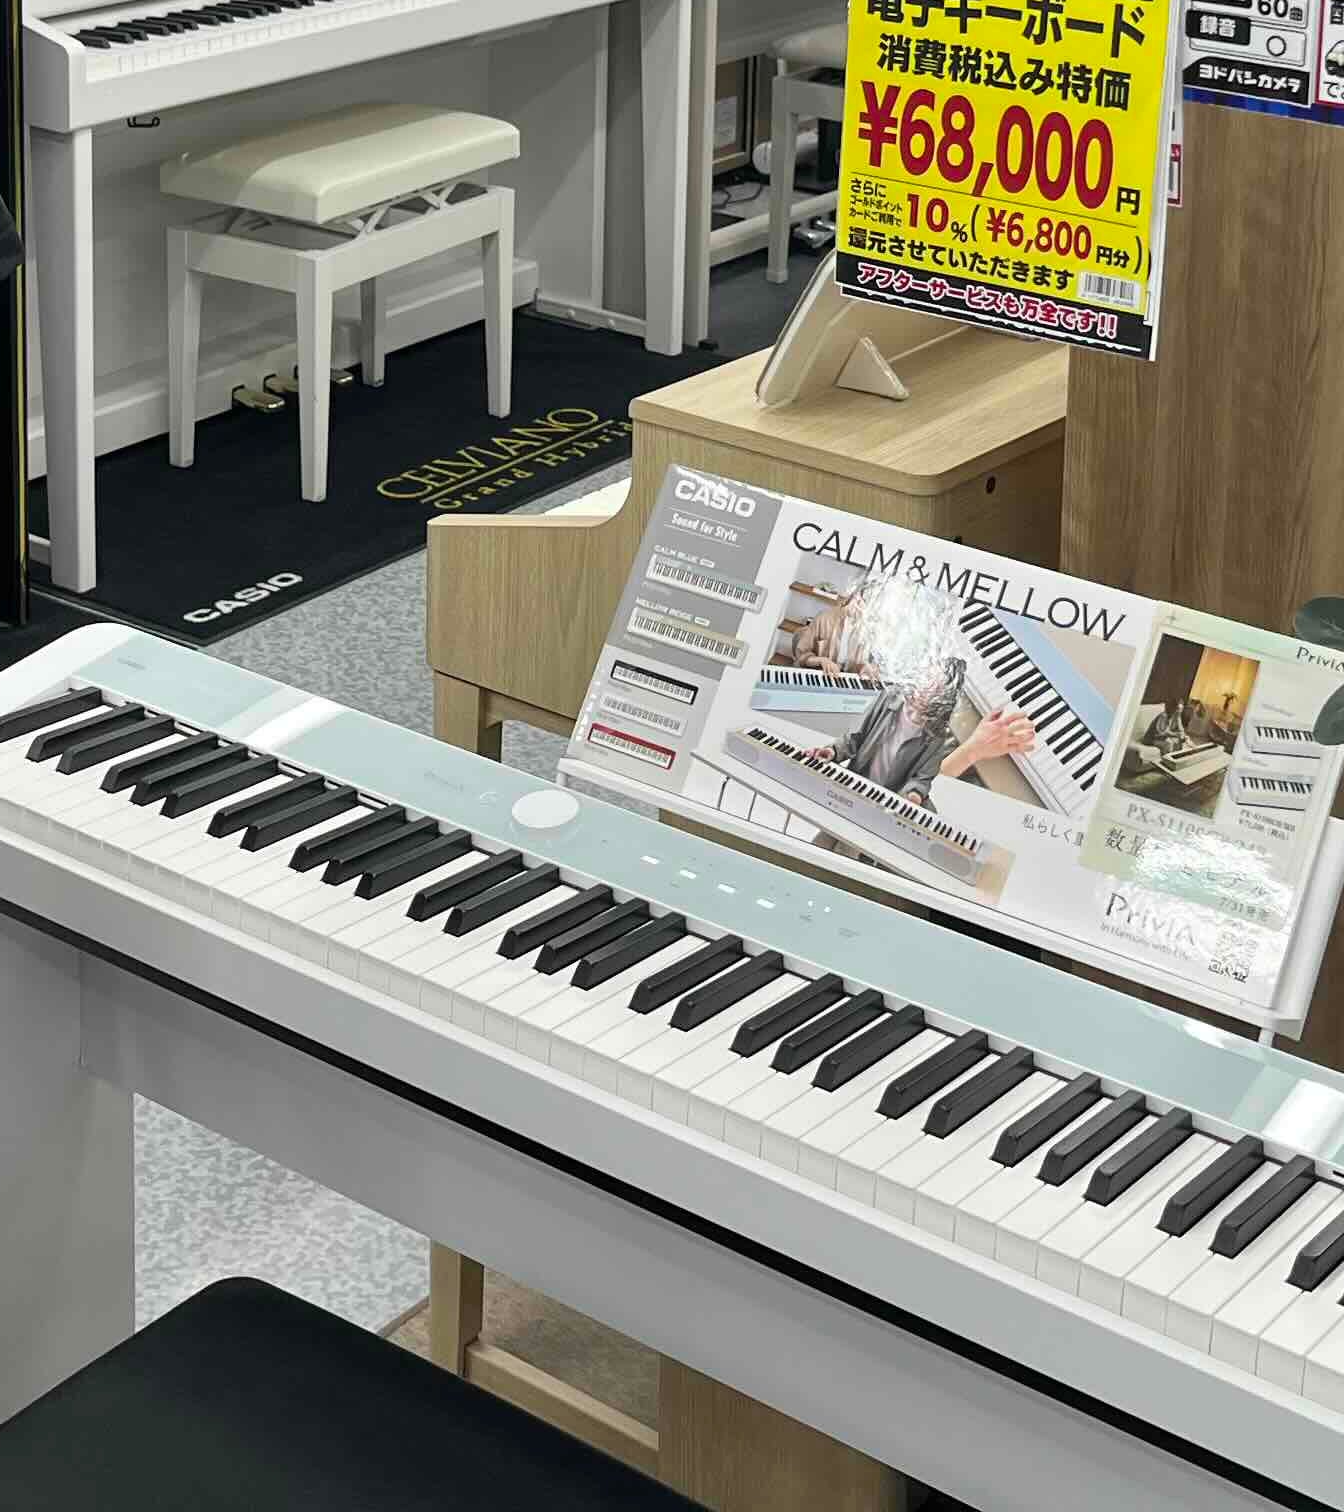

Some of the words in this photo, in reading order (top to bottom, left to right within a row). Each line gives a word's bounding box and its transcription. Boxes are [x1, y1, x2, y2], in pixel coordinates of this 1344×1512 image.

[876, 33, 1132, 111] 消費税込み特価
[1199, 65, 1302, 93] ヨドバシカメラ
[849, 177, 887, 199] さらに
[847, 226, 1075, 290] 還元させていただきます
[376, 407, 600, 500] CELVIANO
[433, 467, 537, 511] Grand
[674, 477, 756, 519] CASIO
[670, 512, 701, 534] Sound
[699, 519, 714, 536] for
[713, 523, 739, 544] Style
[182, 571, 304, 625] CASIO
[792, 521, 905, 581] CALM
[905, 554, 930, 588] &
[935, 561, 1128, 643] MELLOW
